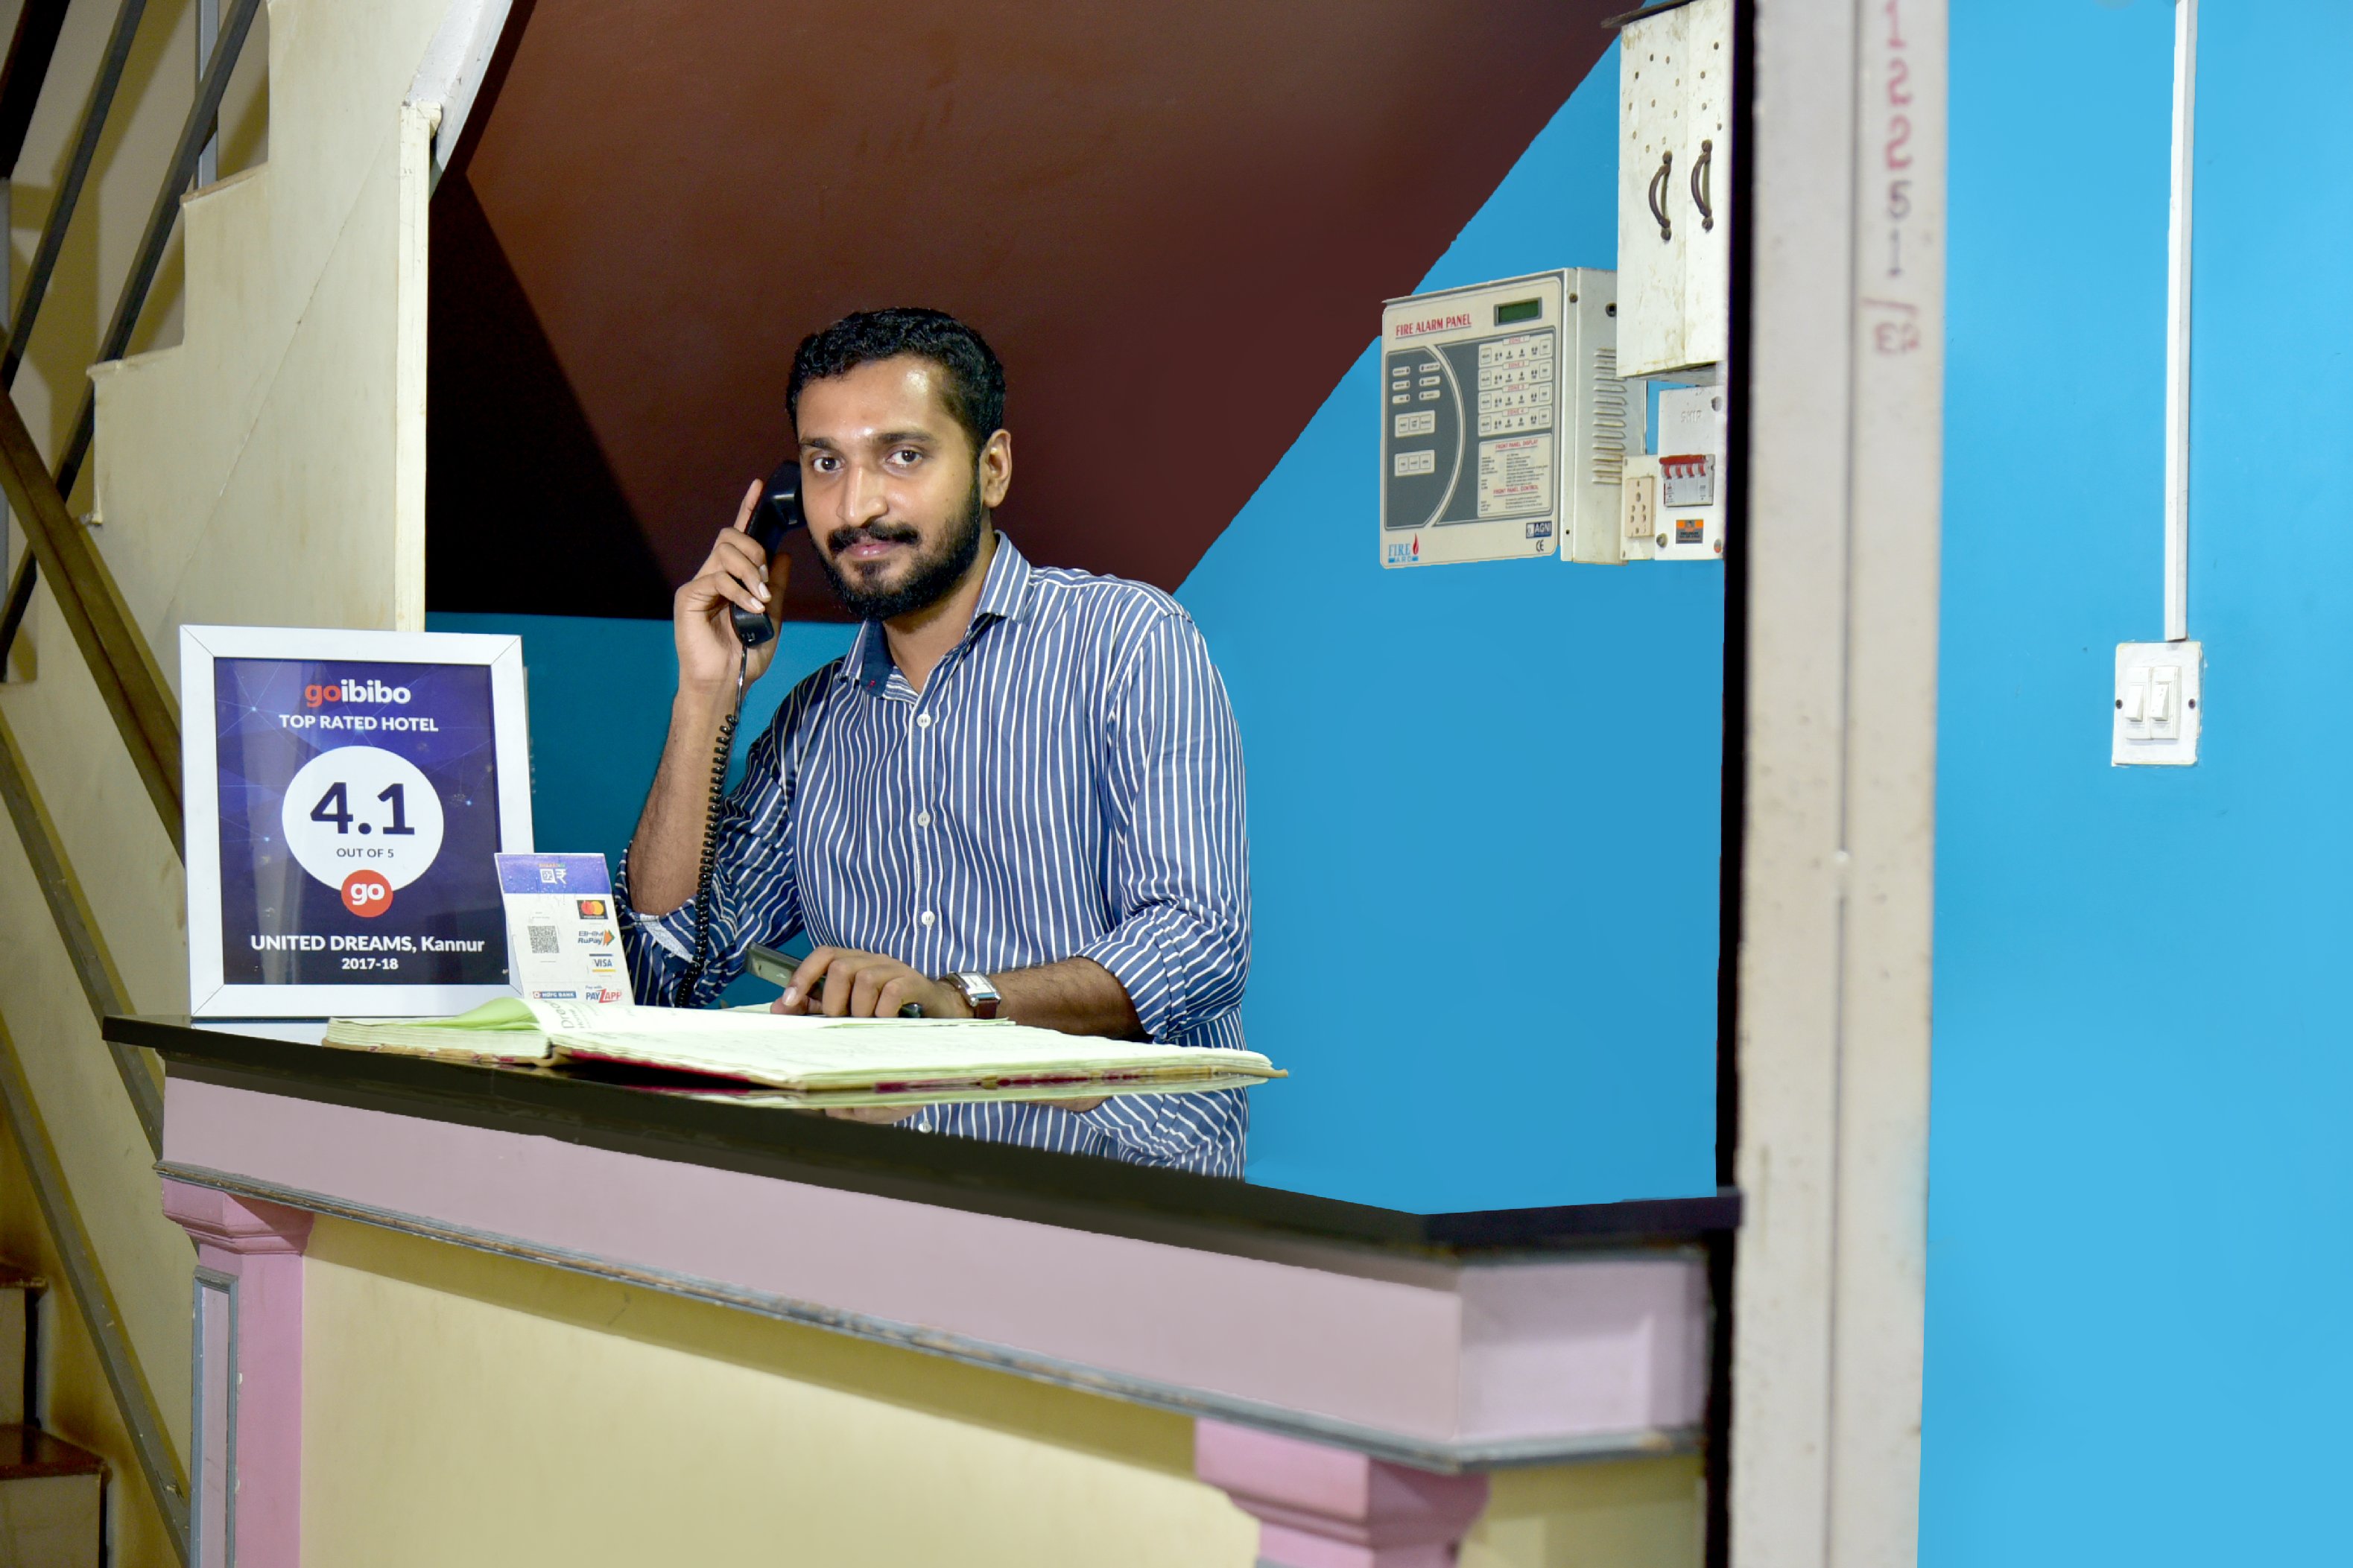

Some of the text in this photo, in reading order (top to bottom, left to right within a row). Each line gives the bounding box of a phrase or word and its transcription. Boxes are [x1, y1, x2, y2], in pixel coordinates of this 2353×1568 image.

[1396, 313, 1472, 336] FIRE ALARM PANEL
[1534, 522, 1551, 533] AGNI
[1388, 544, 1410, 556] FIRE
[304, 679, 411, 708] goibibo
[279, 714, 439, 732] TOP RATED HOTEL
[310, 781, 415, 835] 4.1
[336, 848, 394, 858] OUT OF 5
[350, 883, 385, 906] go
[250, 935, 485, 954] UNITED DREAMS, Kannur
[577, 937, 603, 945] RuPay
[341, 958, 399, 970] 2017-18
[594, 958, 612, 967] VISA
